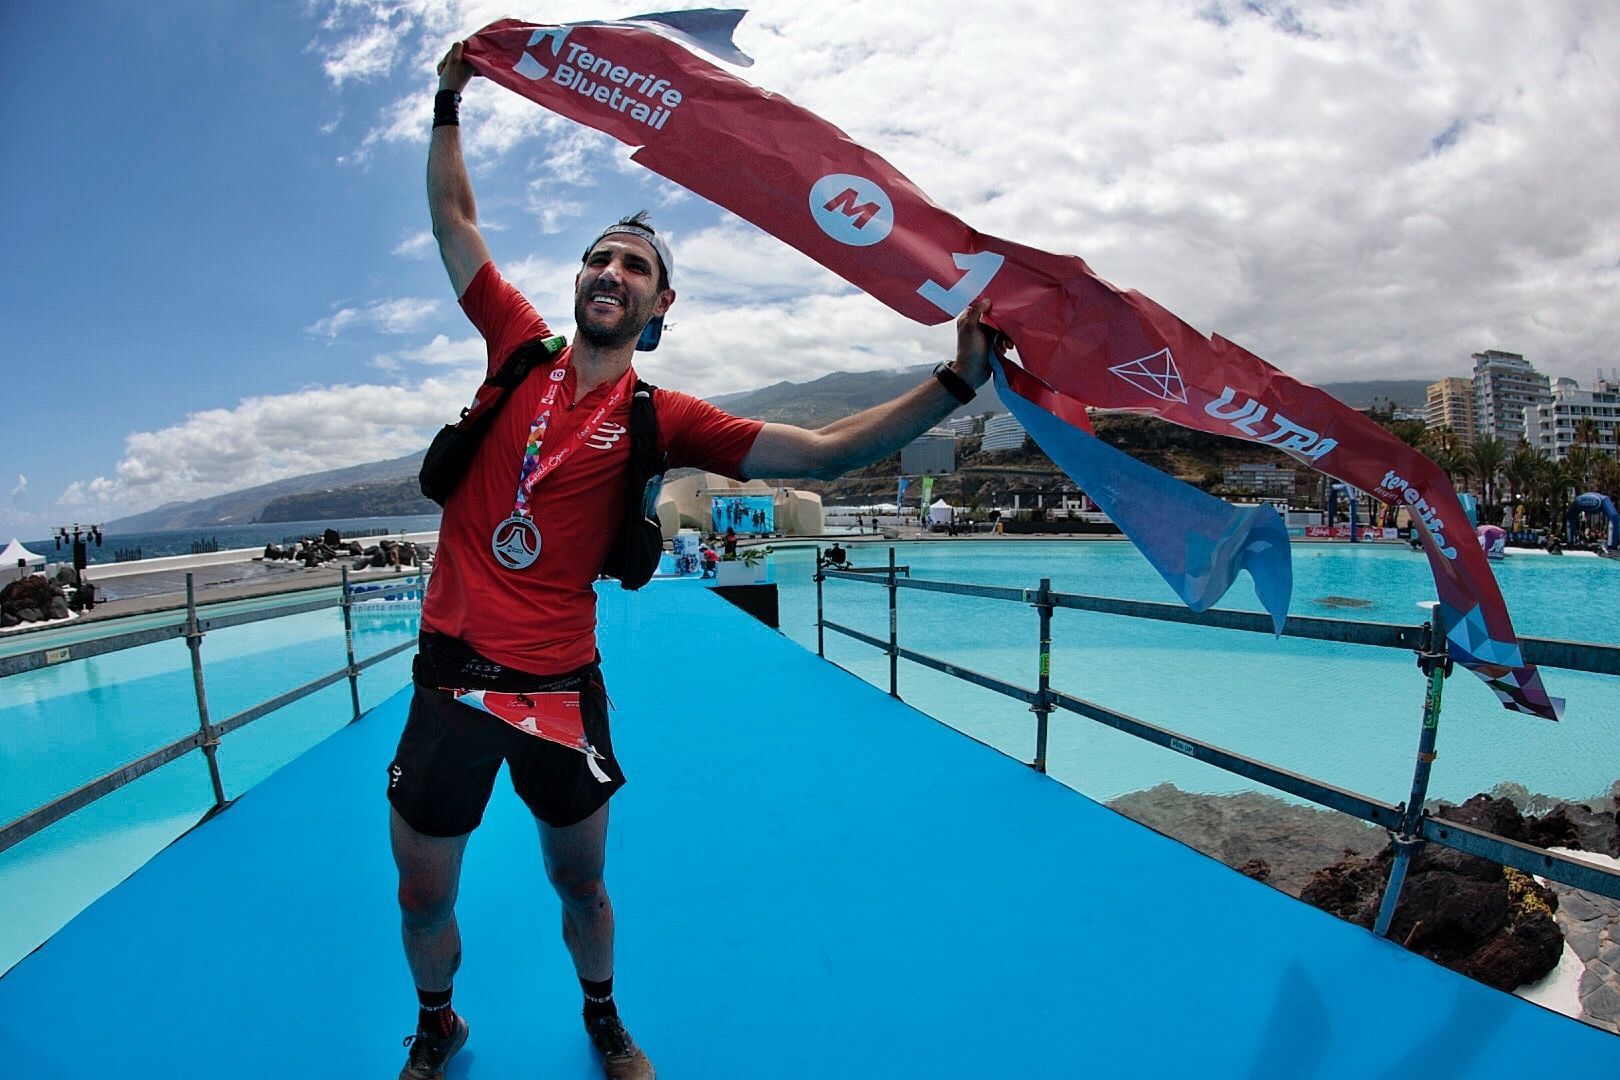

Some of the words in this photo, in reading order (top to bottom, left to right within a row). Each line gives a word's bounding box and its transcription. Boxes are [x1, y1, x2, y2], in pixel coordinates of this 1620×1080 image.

[552, 65, 672, 130] Bluetrail
[568, 42, 682, 108] Tenerife
[823, 188, 881, 230] M
[1204, 386, 1338, 461] ULTRA
